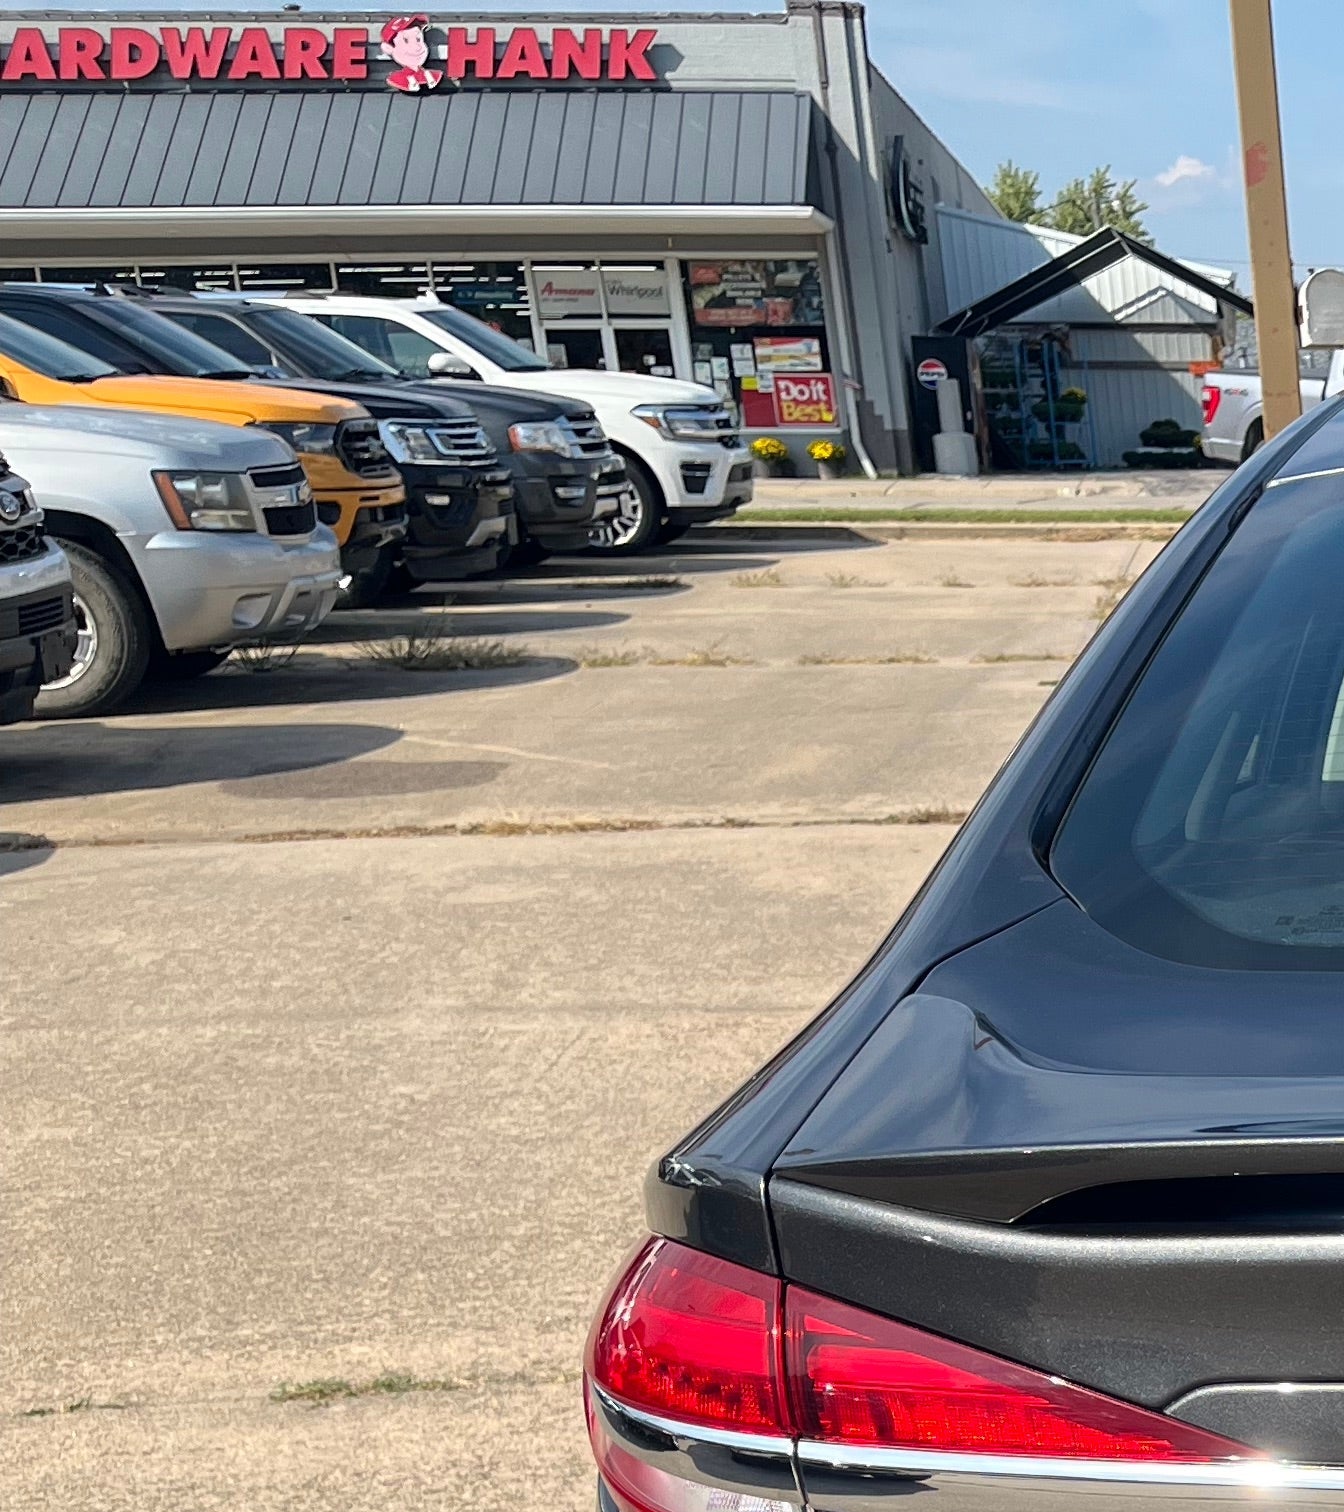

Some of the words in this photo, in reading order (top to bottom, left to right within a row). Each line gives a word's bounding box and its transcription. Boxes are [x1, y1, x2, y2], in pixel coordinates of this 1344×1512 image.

[1, 27, 369, 80] ARDWARE
[447, 27, 658, 80] HANK
[777, 379, 810, 401] Do
[810, 379, 828, 402] it
[781, 400, 830, 422] Best
